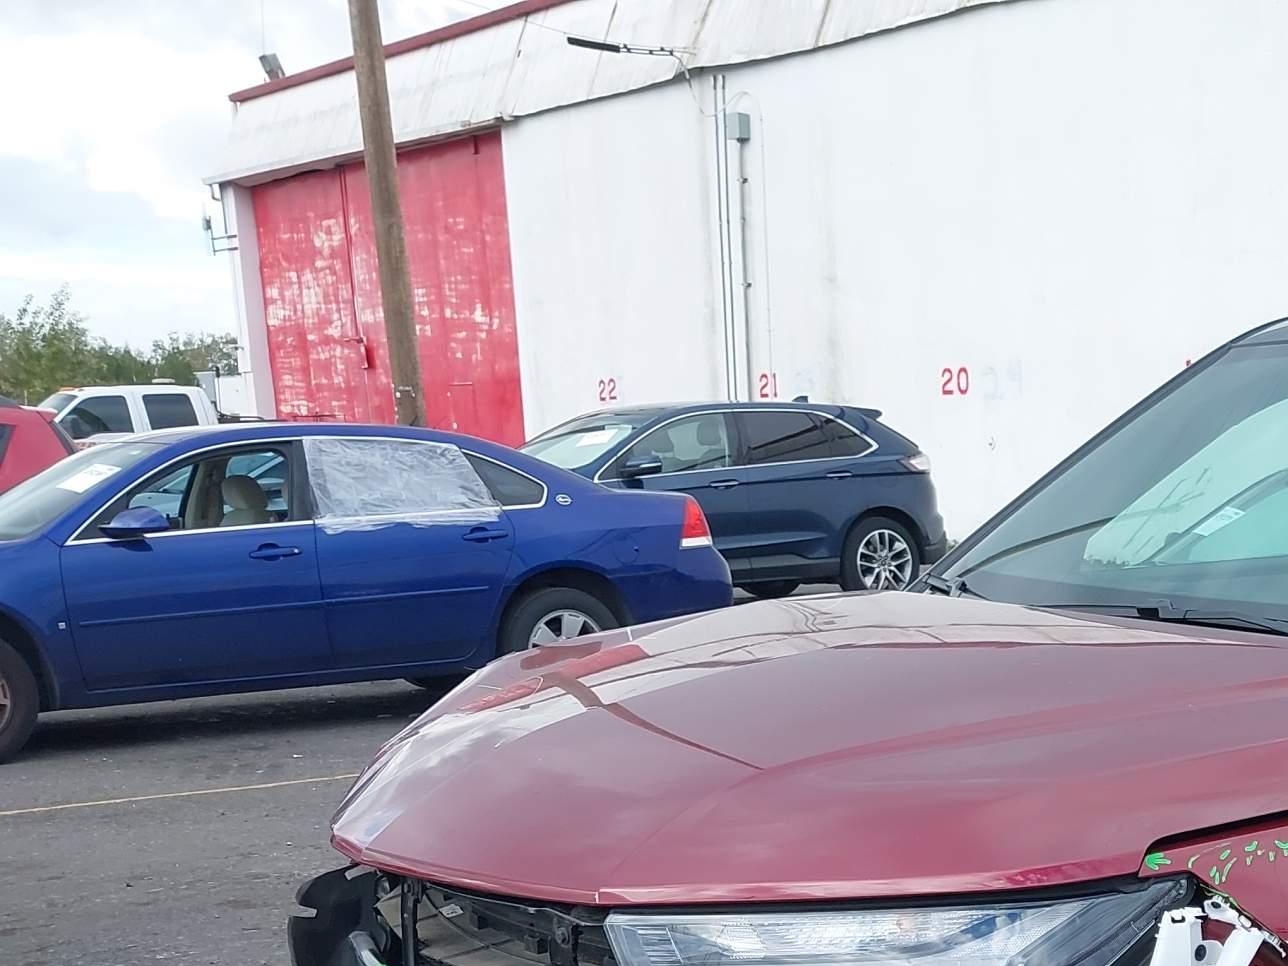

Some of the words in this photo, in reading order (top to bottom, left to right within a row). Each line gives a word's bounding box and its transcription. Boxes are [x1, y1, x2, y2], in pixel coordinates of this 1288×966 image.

[598, 378, 617, 401] 22
[759, 373, 778, 399] 21
[941, 366, 970, 396] 20
